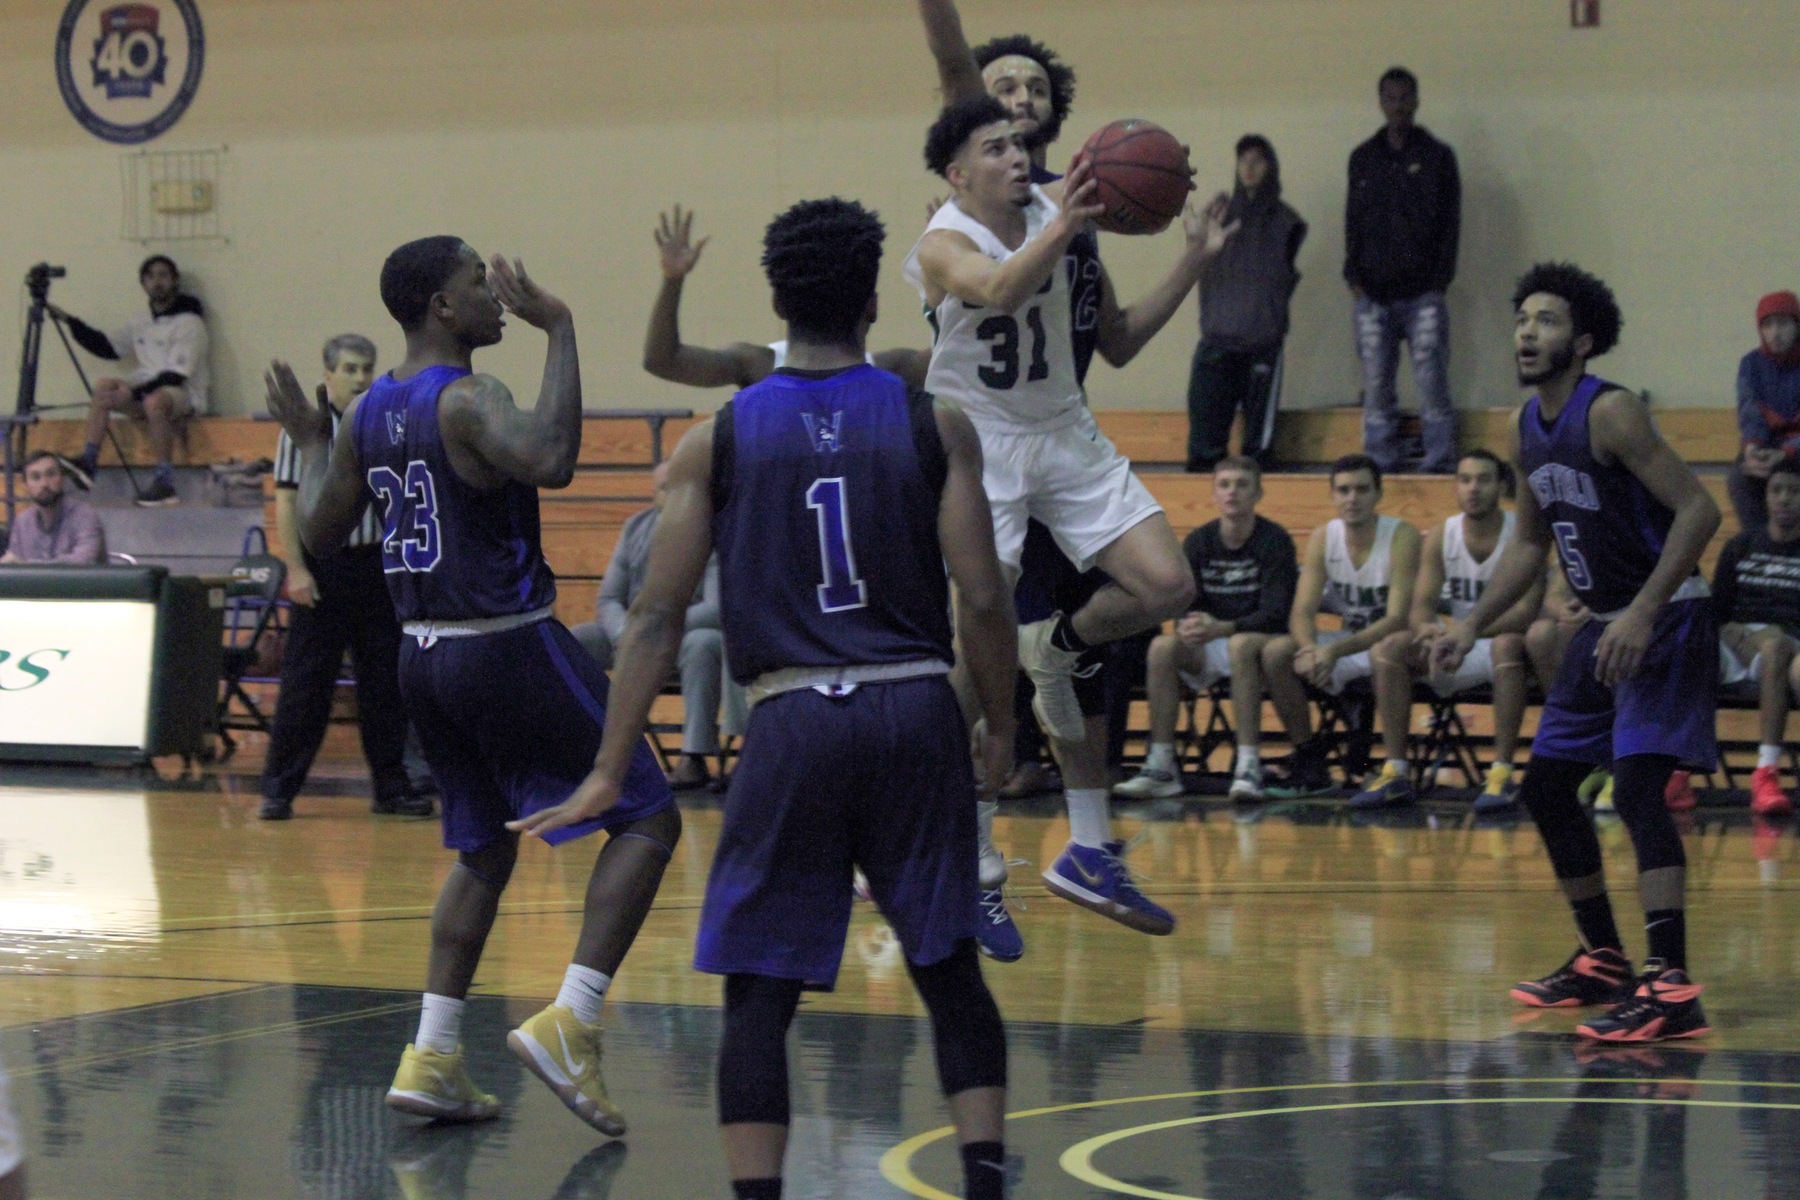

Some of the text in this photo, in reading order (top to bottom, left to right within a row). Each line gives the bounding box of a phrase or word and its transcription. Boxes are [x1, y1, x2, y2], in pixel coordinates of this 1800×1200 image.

[97, 31, 158, 80] 40
[976, 305, 1050, 390] 31
[367, 460, 442, 574] 23
[805, 477, 868, 613] 1
[1551, 522, 1592, 590] 5
